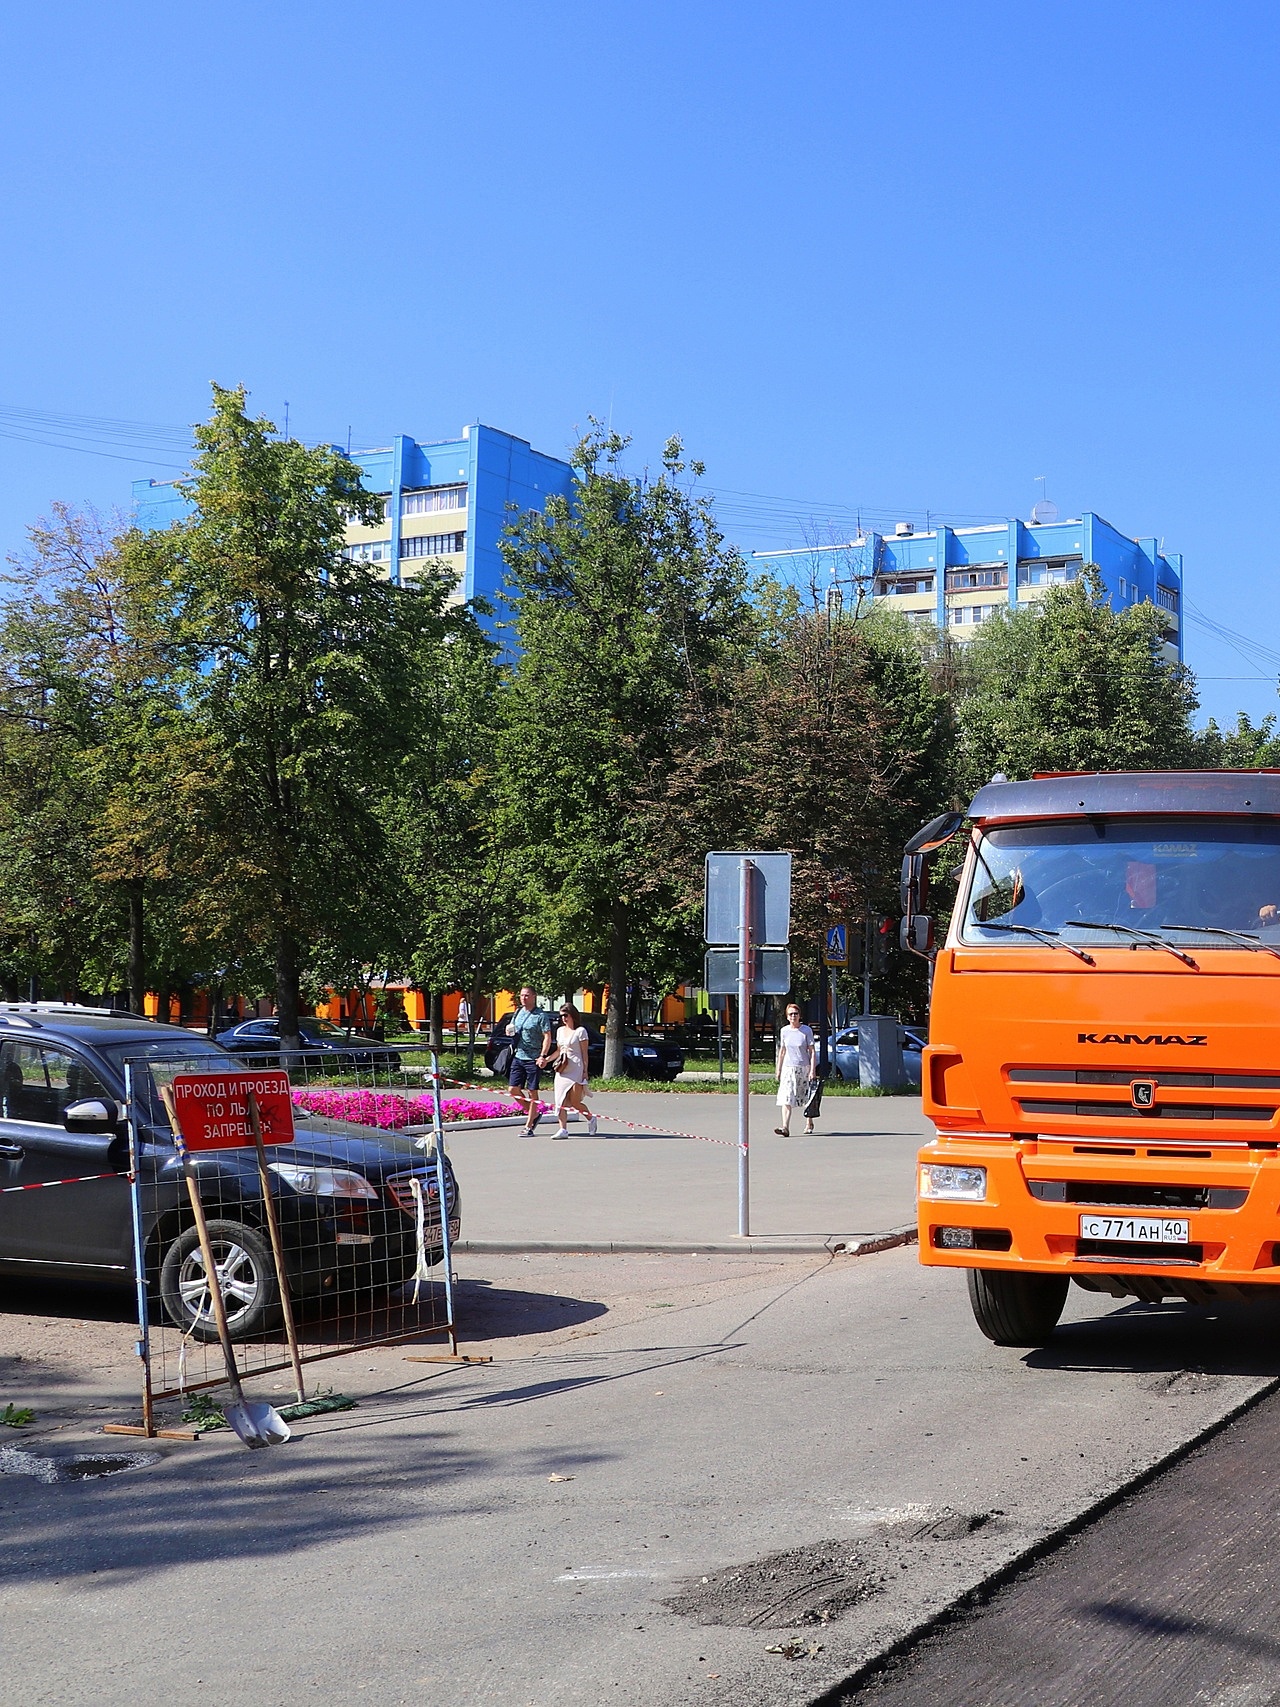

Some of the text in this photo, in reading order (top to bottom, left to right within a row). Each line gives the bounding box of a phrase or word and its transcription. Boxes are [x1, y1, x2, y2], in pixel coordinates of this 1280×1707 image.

[1077, 1033, 1208, 1046] KAMAZ
[175, 1080, 289, 1099] ПРОХОД И ПРОЕЗД
[206, 1103, 225, 1117] ПО
[1164, 1222, 1182, 1236] 40
